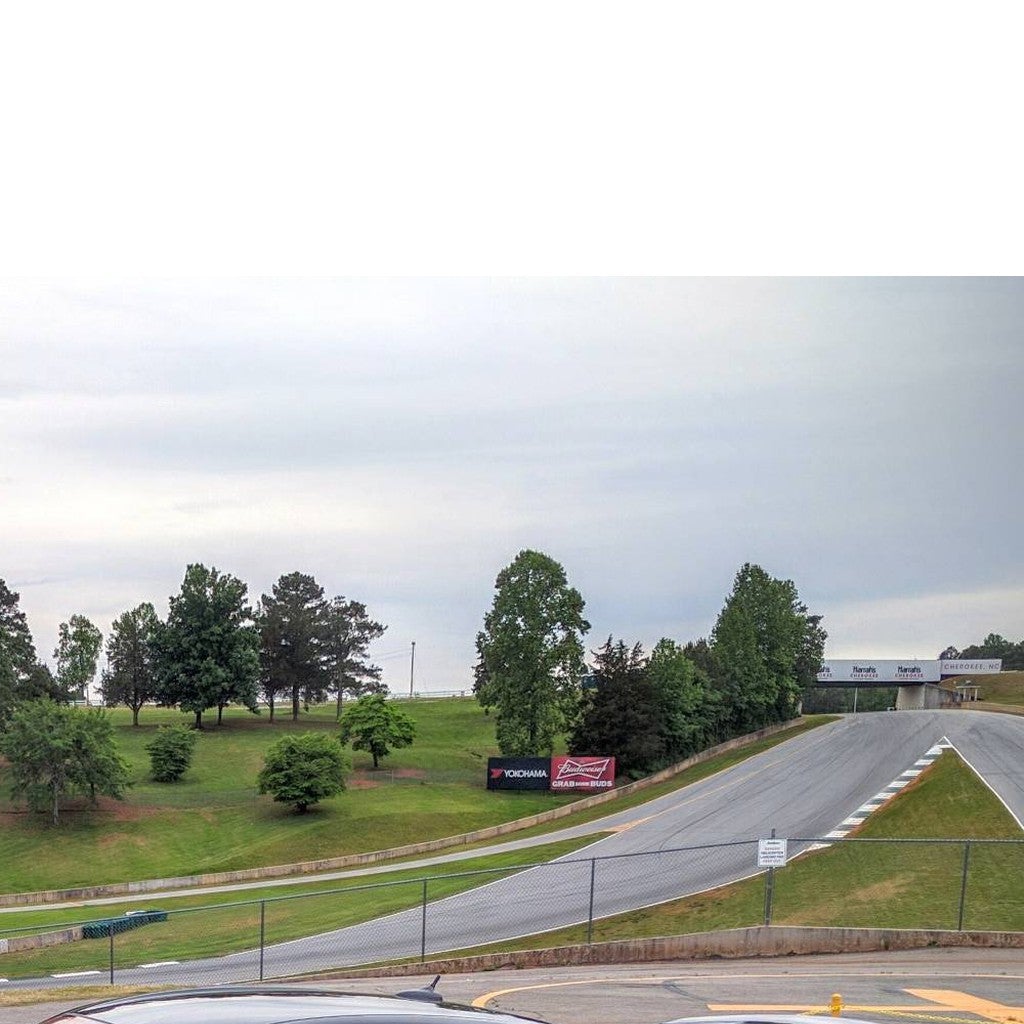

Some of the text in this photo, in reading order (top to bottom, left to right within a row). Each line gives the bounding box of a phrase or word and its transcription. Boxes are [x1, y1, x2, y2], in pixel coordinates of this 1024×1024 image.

[504, 769, 547, 778] YOKOHAMA
[551, 780, 575, 788] GRAB
[590, 780, 613, 788] BUDS
